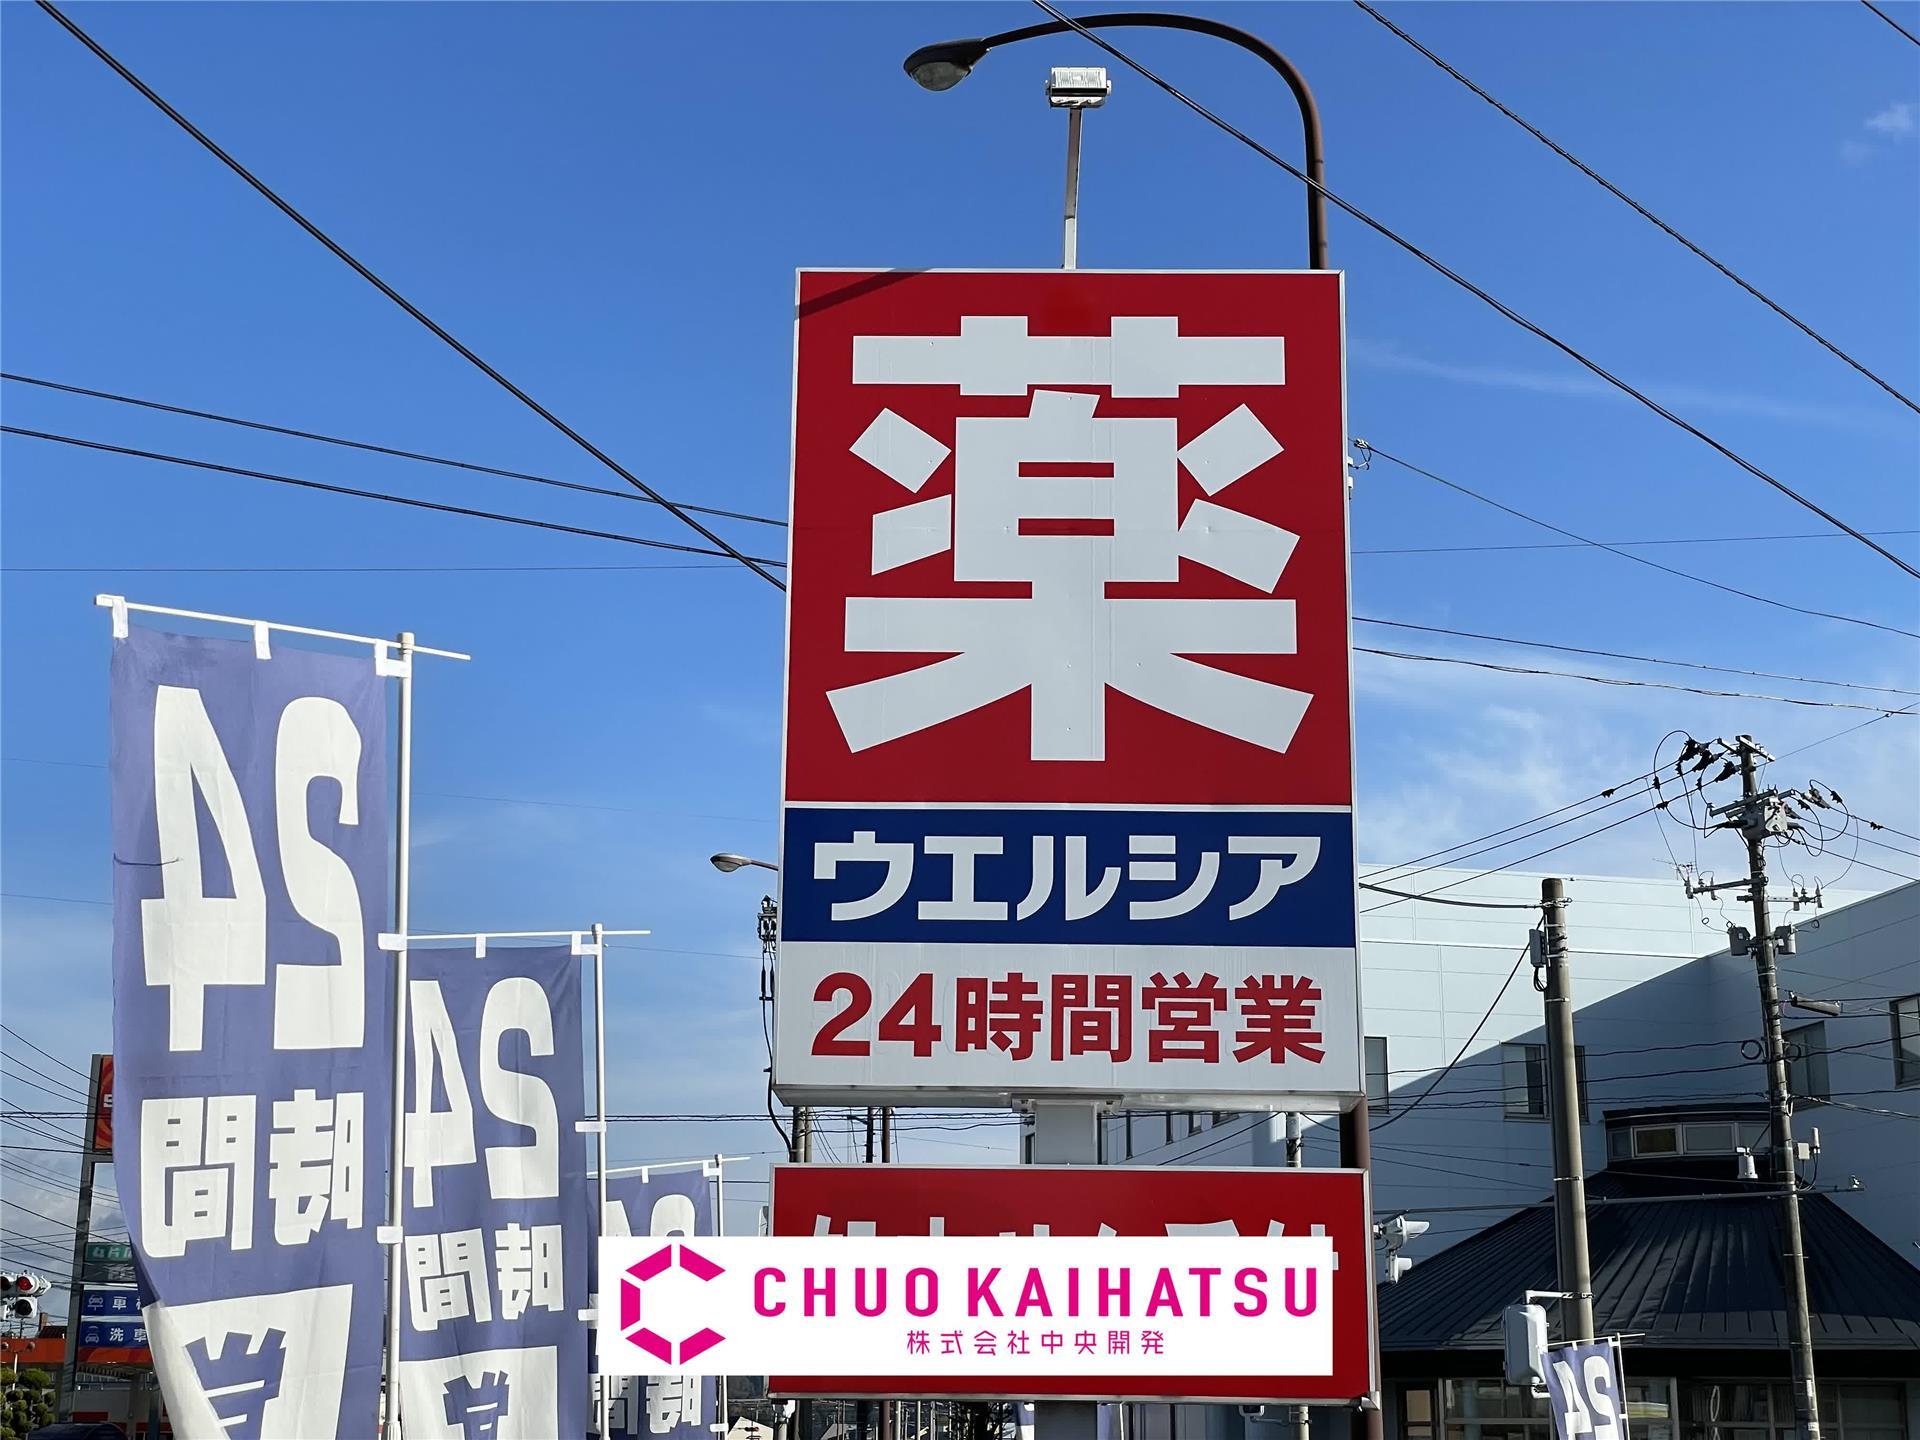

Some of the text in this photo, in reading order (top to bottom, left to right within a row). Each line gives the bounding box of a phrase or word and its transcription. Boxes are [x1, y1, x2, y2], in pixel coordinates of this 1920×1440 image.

[824, 314, 1314, 763] 薬
[813, 830, 1321, 922] ウエルシア
[812, 972, 1326, 1065] 24時間営業
